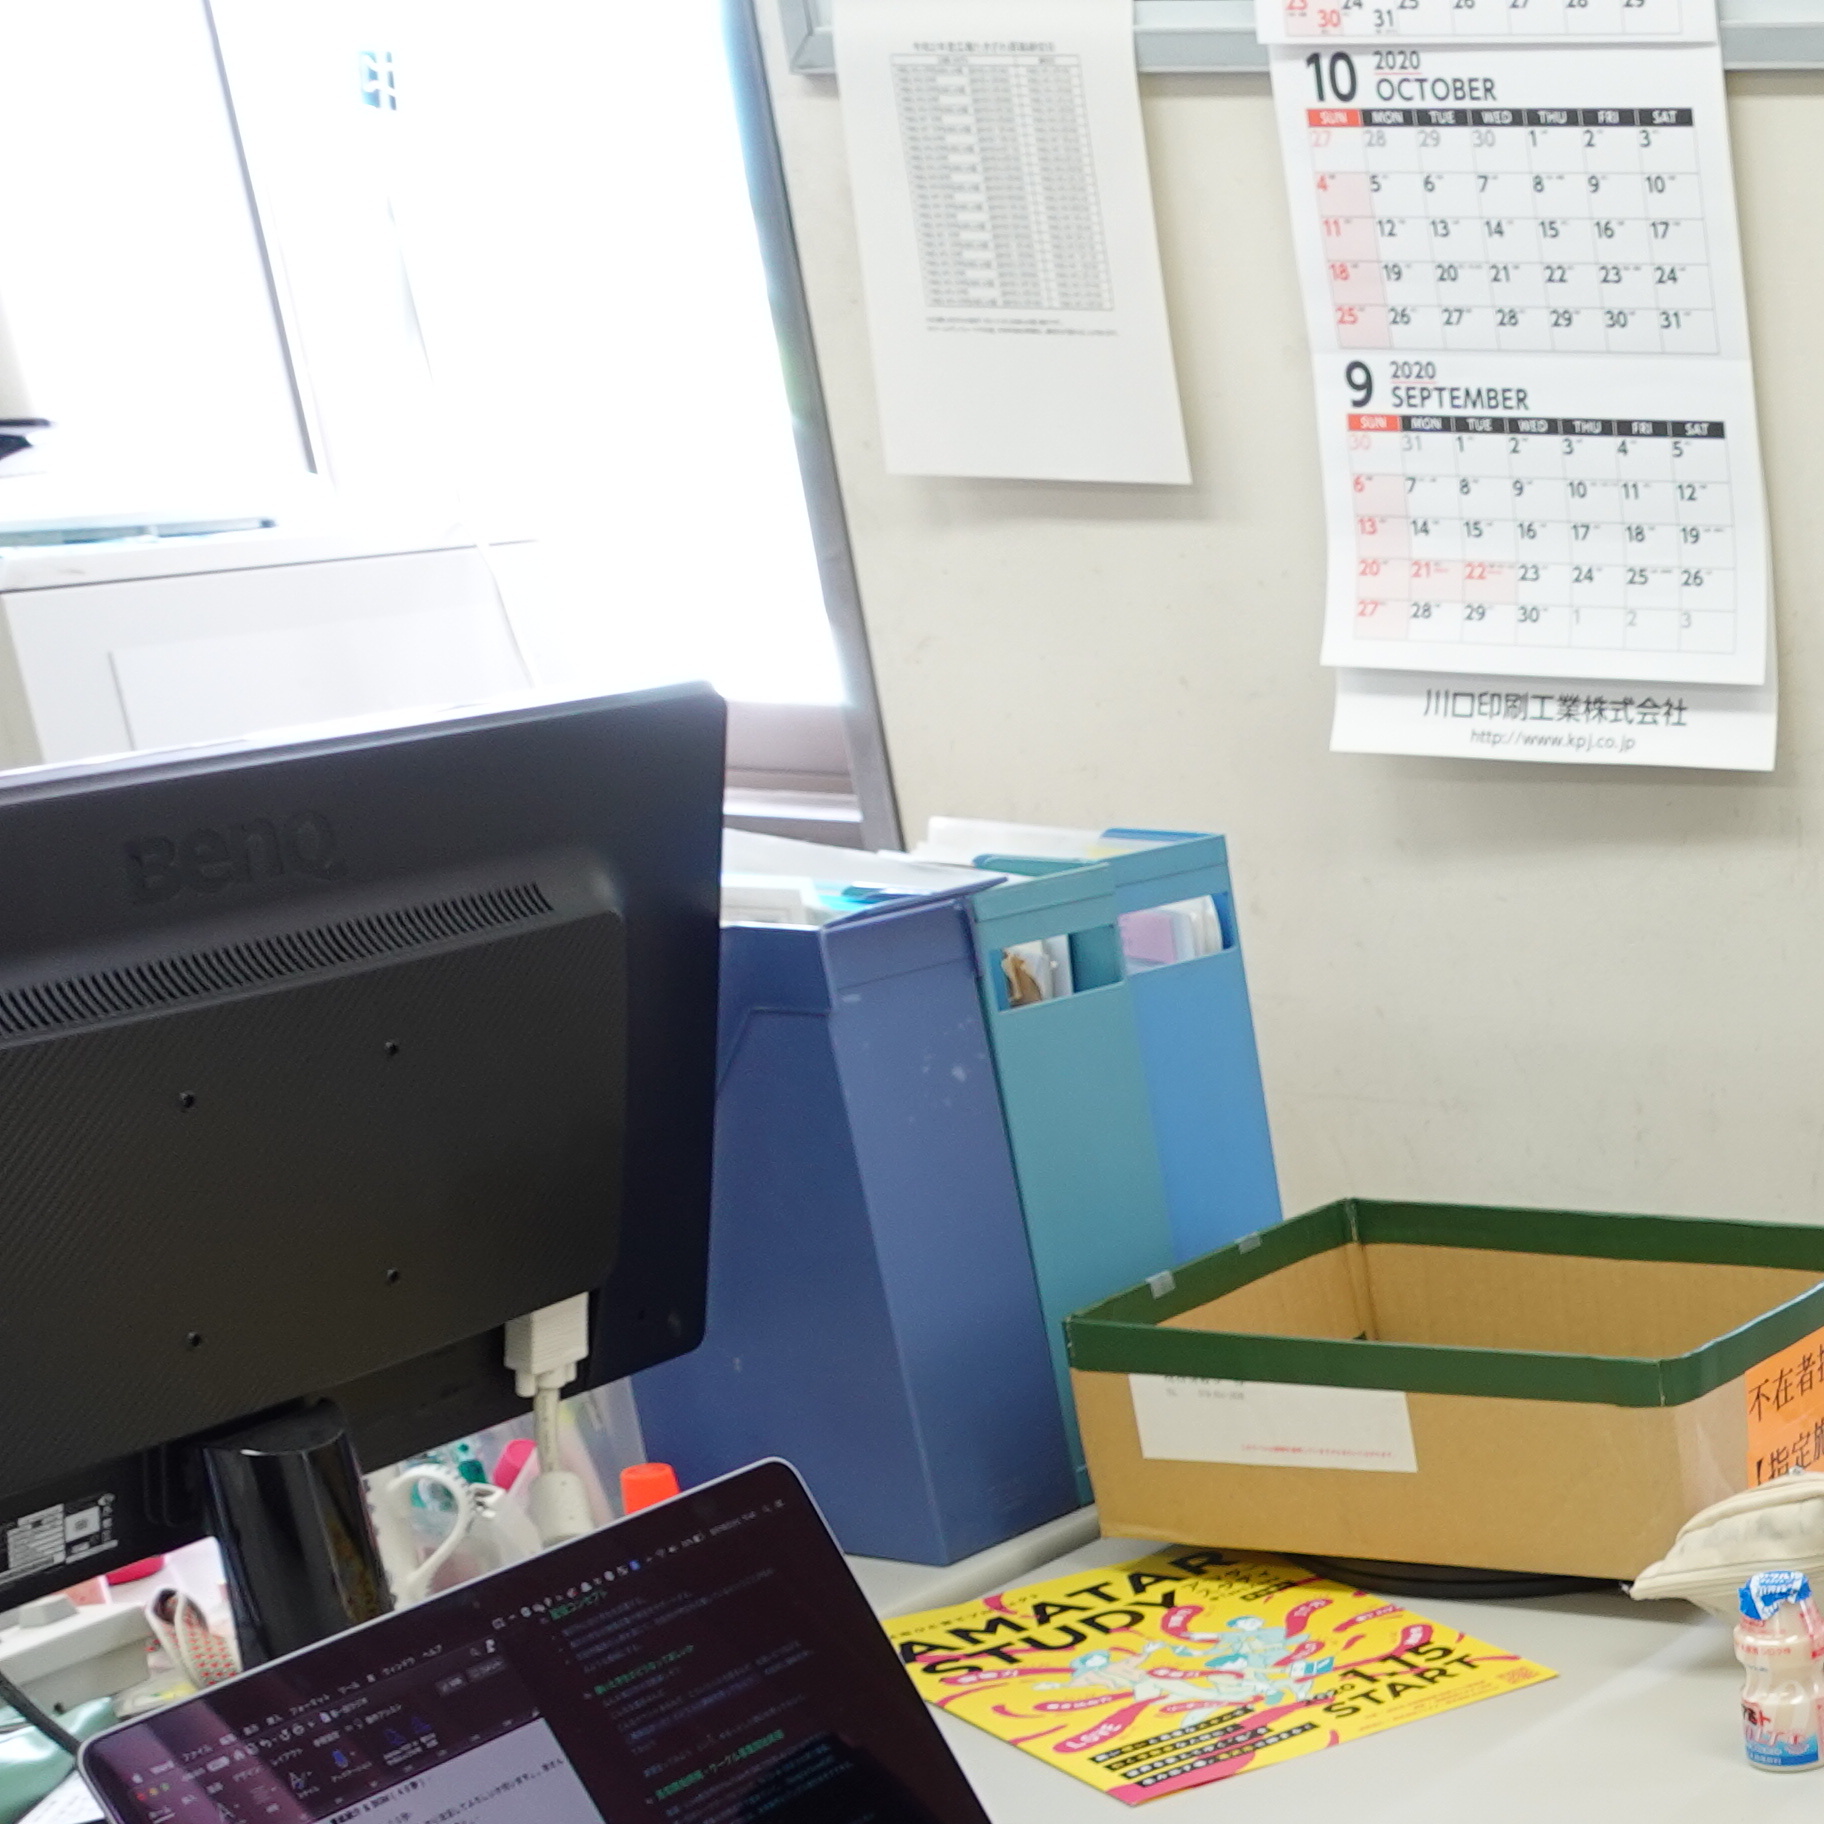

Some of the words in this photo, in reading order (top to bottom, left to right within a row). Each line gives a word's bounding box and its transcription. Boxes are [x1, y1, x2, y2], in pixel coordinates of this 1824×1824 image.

[1317, 9, 1341, 28] 30
[1373, 9, 1395, 28] 31
[1373, 50, 1422, 71] 2020
[1305, 51, 1358, 103] 10
[1375, 77, 1497, 102] OCTOBER
[1318, 111, 1349, 125] SUN
[1371, 111, 1405, 125] MON
[1428, 110, 1456, 125] TUE
[1480, 110, 1513, 125] WED
[1537, 110, 1568, 125] THU
[1597, 110, 1621, 125] FRI
[1651, 110, 1678, 125] SAT
[1311, 129, 1332, 148] 27
[1365, 129, 1388, 148] 28
[1418, 129, 1442, 148] 29
[1472, 129, 1496, 148] 30
[1528, 129, 1539, 148] 1
[1583, 129, 1596, 148] 2
[1638, 129, 1652, 148] 3
[1316, 174, 1329, 193] 4
[1369, 174, 1382, 193] 5
[1423, 174, 1436, 193] 6
[1477, 174, 1488, 193] 7
[1532, 174, 1545, 193] 8
[1587, 175, 1600, 194] 9
[1646, 175, 1666, 194] 10
[1323, 219, 1342, 238] 11
[1378, 219, 1398, 238] 12
[1431, 219, 1451, 238] 13
[1484, 219, 1505, 239] 14
[1539, 219, 1560, 239] 15
[1594, 220, 1615, 239] 16
[1650, 220, 1670, 239] 17
[1330, 263, 1350, 282] 18
[1383, 263, 1403, 282] 19
[1436, 264, 1460, 282] 20
[1489, 264, 1511, 283] 21
[1544, 264, 1568, 284] 22
[1599, 264, 1623, 284] 23
[1654, 265, 1679, 284] 24
[1336, 307, 1358, 325] 25
[1388, 307, 1411, 325] 26
[1442, 307, 1465, 326] 27
[1496, 308, 1520, 327] 28
[1550, 309, 1574, 328] 29
[1604, 309, 1629, 329] 30
[1659, 310, 1682, 329] 31
[1390, 361, 1437, 380] 2020
[1343, 360, 1375, 409] 9
[1391, 386, 1530, 410] SEPTEMBER
[1359, 417, 1388, 430] SUN
[1410, 417, 1443, 431] MON
[1466, 417, 1493, 431] TUE
[1517, 418, 1549, 433] WED
[1572, 420, 1603, 434] THU
[1631, 422, 1653, 435] FRI
[1684, 422, 1709, 436] SAT
[1349, 433, 1372, 451] 30
[1402, 435, 1423, 453] 31
[1455, 435, 1465, 453] 1
[1508, 436, 1521, 454] 2
[1563, 437, 1575, 456] 3
[1616, 439, 1629, 457] 4
[1672, 439, 1684, 458] 5
[1353, 476, 1365, 493] 6
[1406, 477, 1417, 494] 7
[1460, 478, 1471, 496] 8
[1512, 478, 1525, 496] 9
[1568, 479, 1588, 499] 10
[1622, 481, 1640, 500] 11
[1677, 482, 1698, 501] 12
[1358, 517, 1378, 535] 13
[1412, 518, 1430, 536] 14
[1464, 520, 1483, 539] 15
[1517, 521, 1538, 540] 16
[1572, 522, 1591, 541] 17
[1626, 524, 1646, 543] 18
[1680, 526, 1700, 544] 19
[1358, 559, 1381, 577] 20
[1411, 560, 1433, 579] 21
[1464, 561, 1487, 580] 22
[1517, 563, 1541, 582] 23
[1572, 565, 1595, 583] 24
[1626, 567, 1649, 586] 25
[1680, 568, 1704, 587] 26
[1357, 599, 1379, 618] 27
[1410, 601, 1433, 620] 28
[1464, 604, 1487, 622] 29
[1517, 604, 1540, 623] 30
[1573, 608, 1582, 626] 1
[1626, 610, 1638, 628] 2
[1680, 612, 1693, 630] 3
[1423, 689, 1689, 727] 川口印刷工業株式会社
[1469, 728, 1637, 752] http://www.kpj.co.jp
[122, 811, 349, 903] BenQ
[921, 1589, 1178, 1675] STUDY
[1322, 1653, 1480, 1720] START
[1064, 1721, 1122, 1750] LOVE
